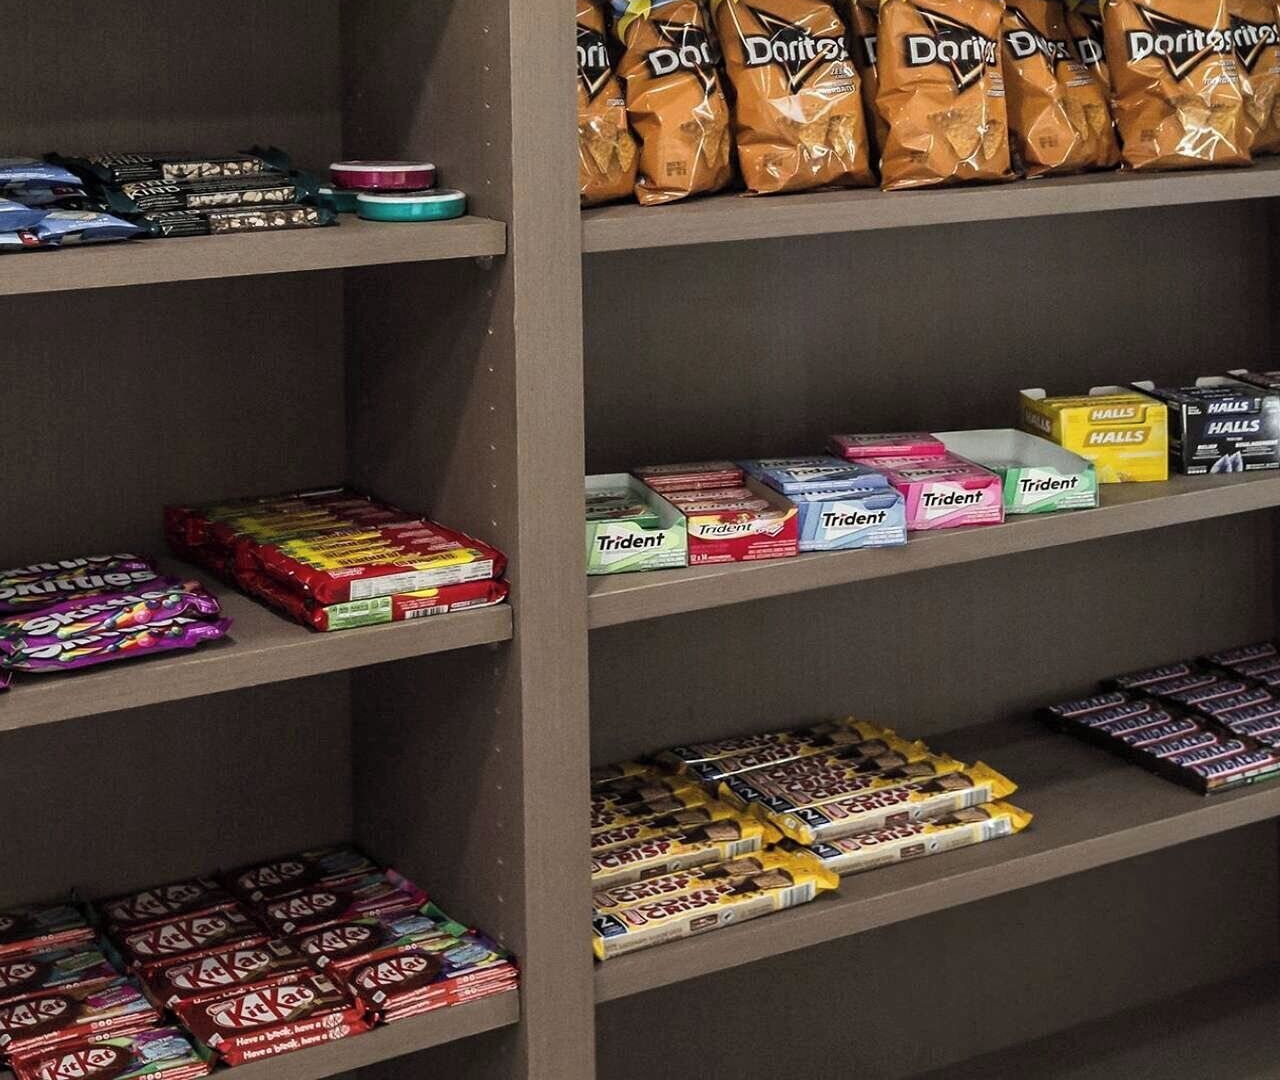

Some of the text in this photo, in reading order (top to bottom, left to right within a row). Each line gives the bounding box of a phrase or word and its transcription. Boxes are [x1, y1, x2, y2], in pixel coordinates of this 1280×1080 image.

[748, 36, 848, 64] Doritos
[1130, 29, 1234, 60] Doritos
[128, 185, 181, 201] KIND
[1091, 407, 1136, 420] HALLS
[1208, 399, 1250, 414] HALLS
[1089, 429, 1145, 445] HALLS
[1207, 418, 1261, 434] HALLS
[1020, 475, 1079, 493] Trident
[922, 490, 984, 508] Trident
[699, 522, 753, 536] Trident
[821, 510, 888, 528] Trident
[596, 531, 666, 552] Trident
[845, 792, 911, 815] CRISP
[858, 824, 925, 846] CRISP
[601, 842, 671, 870] CRISP
[617, 878, 690, 903] CRISP
[274, 893, 337, 920] KitKat
[645, 892, 721, 920] CRISP
[134, 919, 227, 956] KitKat
[306, 926, 370, 954] KitKat
[173, 950, 270, 990] KitKat
[363, 956, 428, 990] KitKat
[215, 984, 315, 1028] KitKat
[237, 1033, 259, 1047] Have
[294, 1024, 315, 1034] have
[243, 1048, 266, 1060] Have
[301, 1036, 321, 1047] have
[38, 1049, 119, 1080] KitKat
